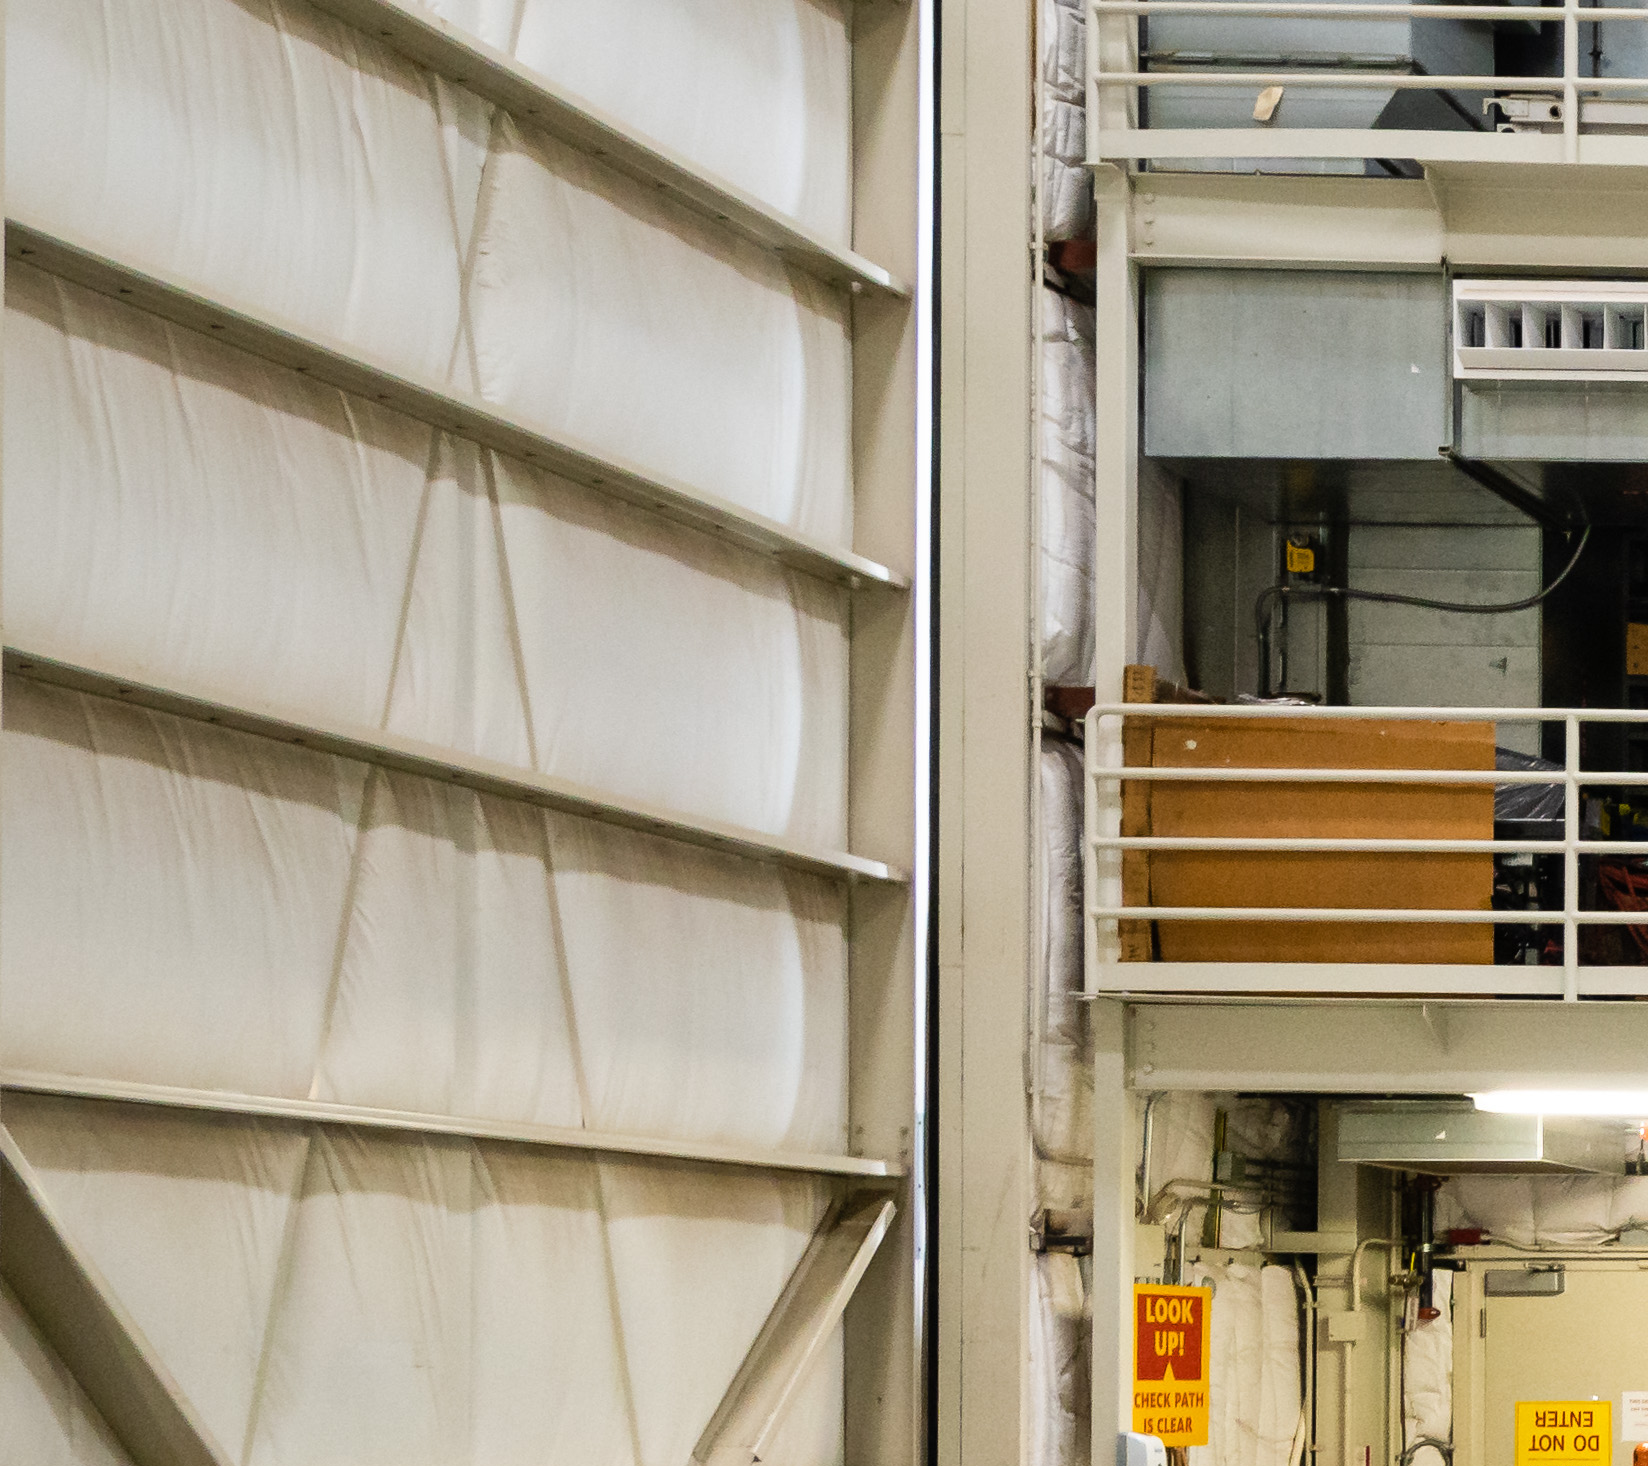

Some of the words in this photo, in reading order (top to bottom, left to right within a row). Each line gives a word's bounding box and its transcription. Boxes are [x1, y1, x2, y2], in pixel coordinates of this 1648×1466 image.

[1146, 1297, 1193, 1324] LOOK
[1154, 1330, 1185, 1357] UP!
[1134, 1391, 1171, 1408] CHECK
[1174, 1391, 1204, 1408] PATH
[1143, 1417, 1154, 1433] IS
[1157, 1416, 1193, 1433] CLEAR
[1535, 1411, 1594, 1428] ENTER
[1528, 1434, 1565, 1451] NOT
[1574, 1434, 1600, 1451] DO
